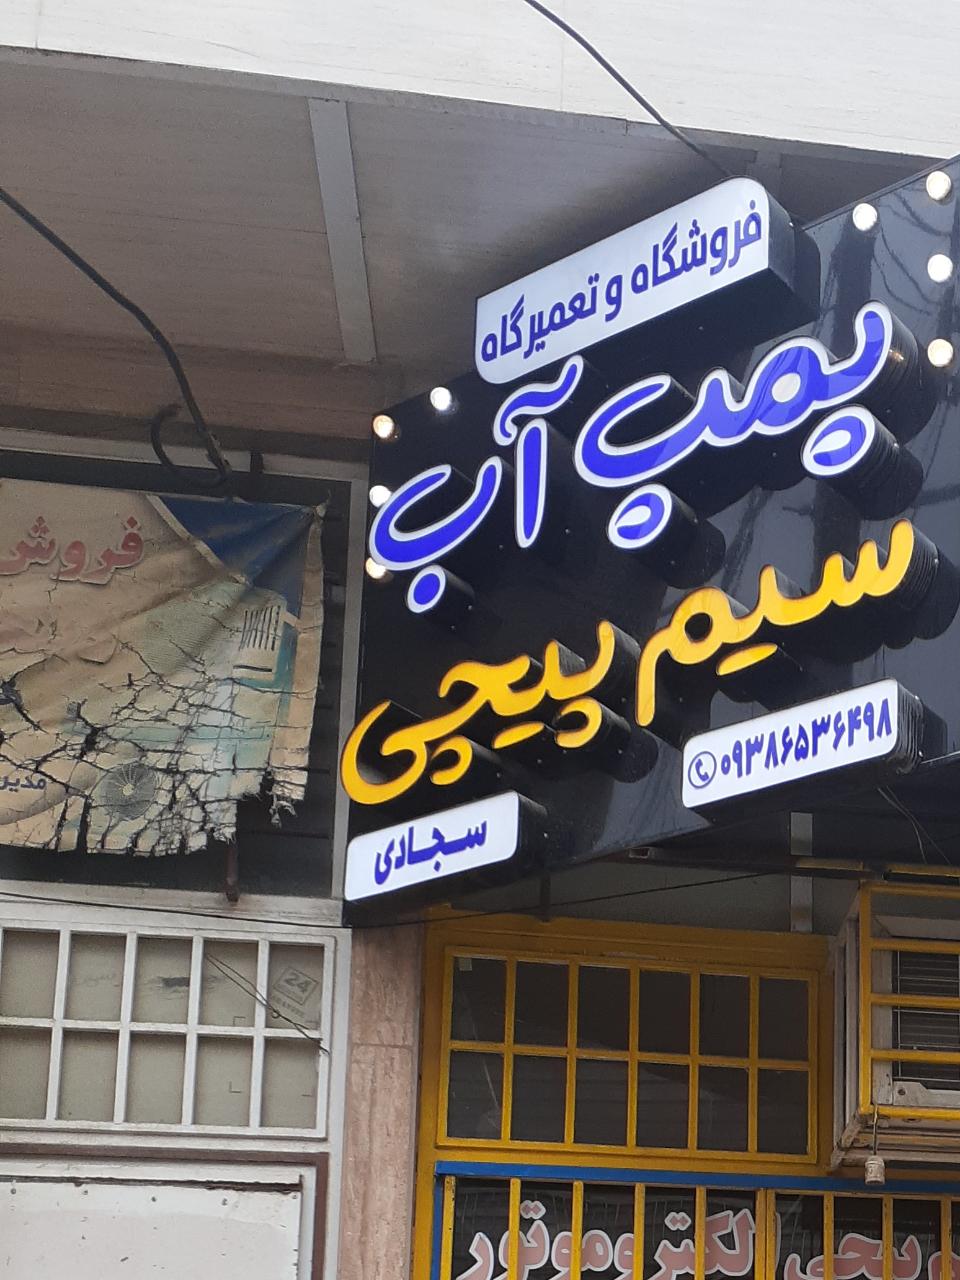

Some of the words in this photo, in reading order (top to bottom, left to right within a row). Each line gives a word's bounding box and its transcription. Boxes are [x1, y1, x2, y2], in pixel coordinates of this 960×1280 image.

[630, 199, 763, 294] فروشگاه
[481, 272, 600, 362] تعمیرگاه
[604, 274, 623, 322] و
[574, 299, 893, 550] پمپ
[368, 355, 584, 614] آب
[636, 518, 914, 727] سیم
[340, 620, 615, 805] پیچی
[721, 698, 892, 778] ۰۹۳۸۶۵۳۶۴۹۸
[373, 820, 488, 886] سجادی
